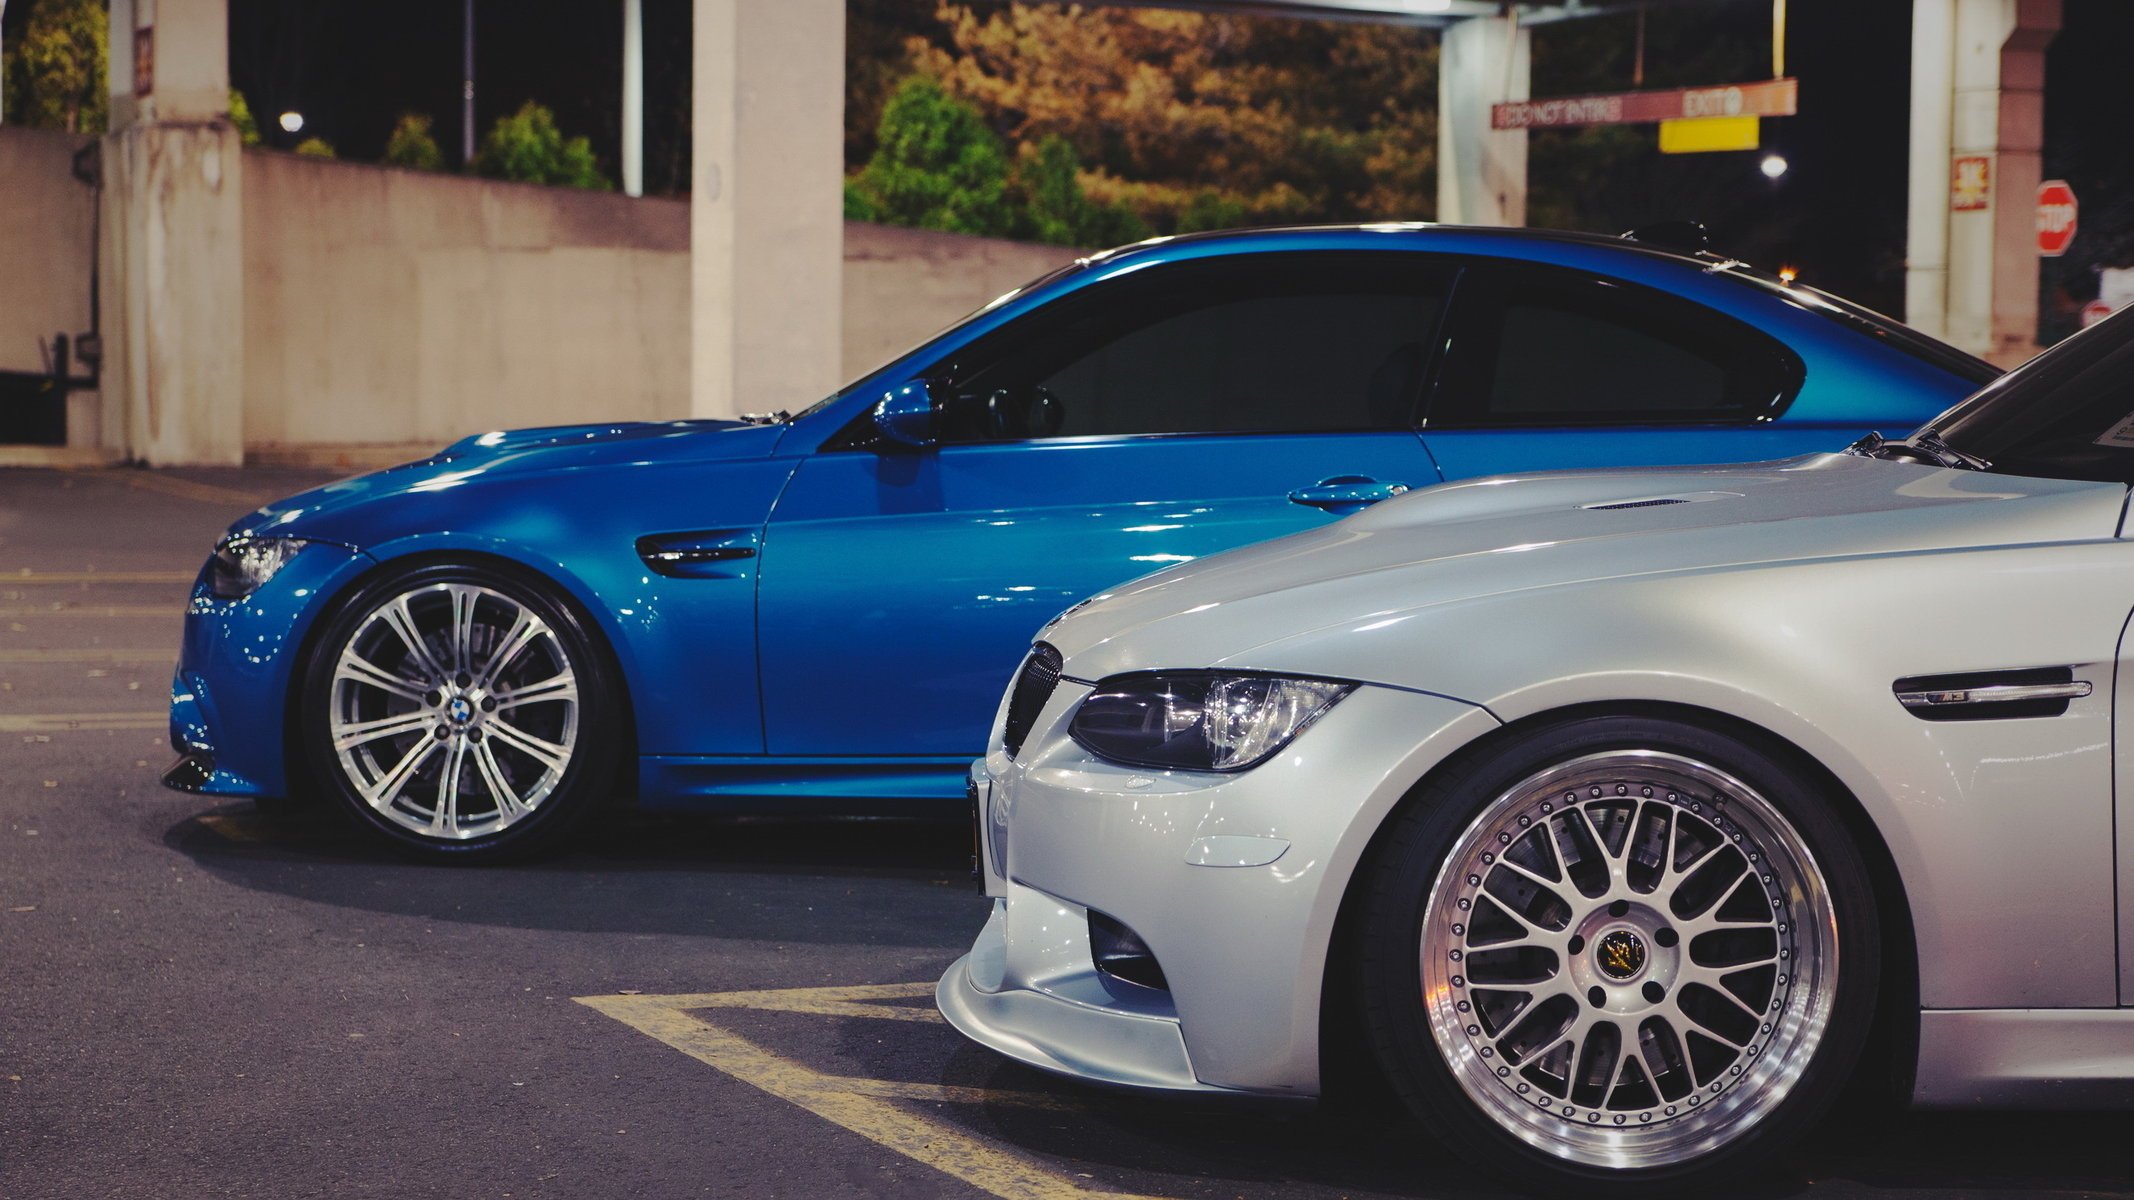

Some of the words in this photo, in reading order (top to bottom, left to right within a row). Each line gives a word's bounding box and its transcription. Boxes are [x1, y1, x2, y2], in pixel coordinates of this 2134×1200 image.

[1534, 101, 1566, 125] NOT
[1683, 90, 1727, 117] EXIT
[2034, 204, 2076, 232] STOP
